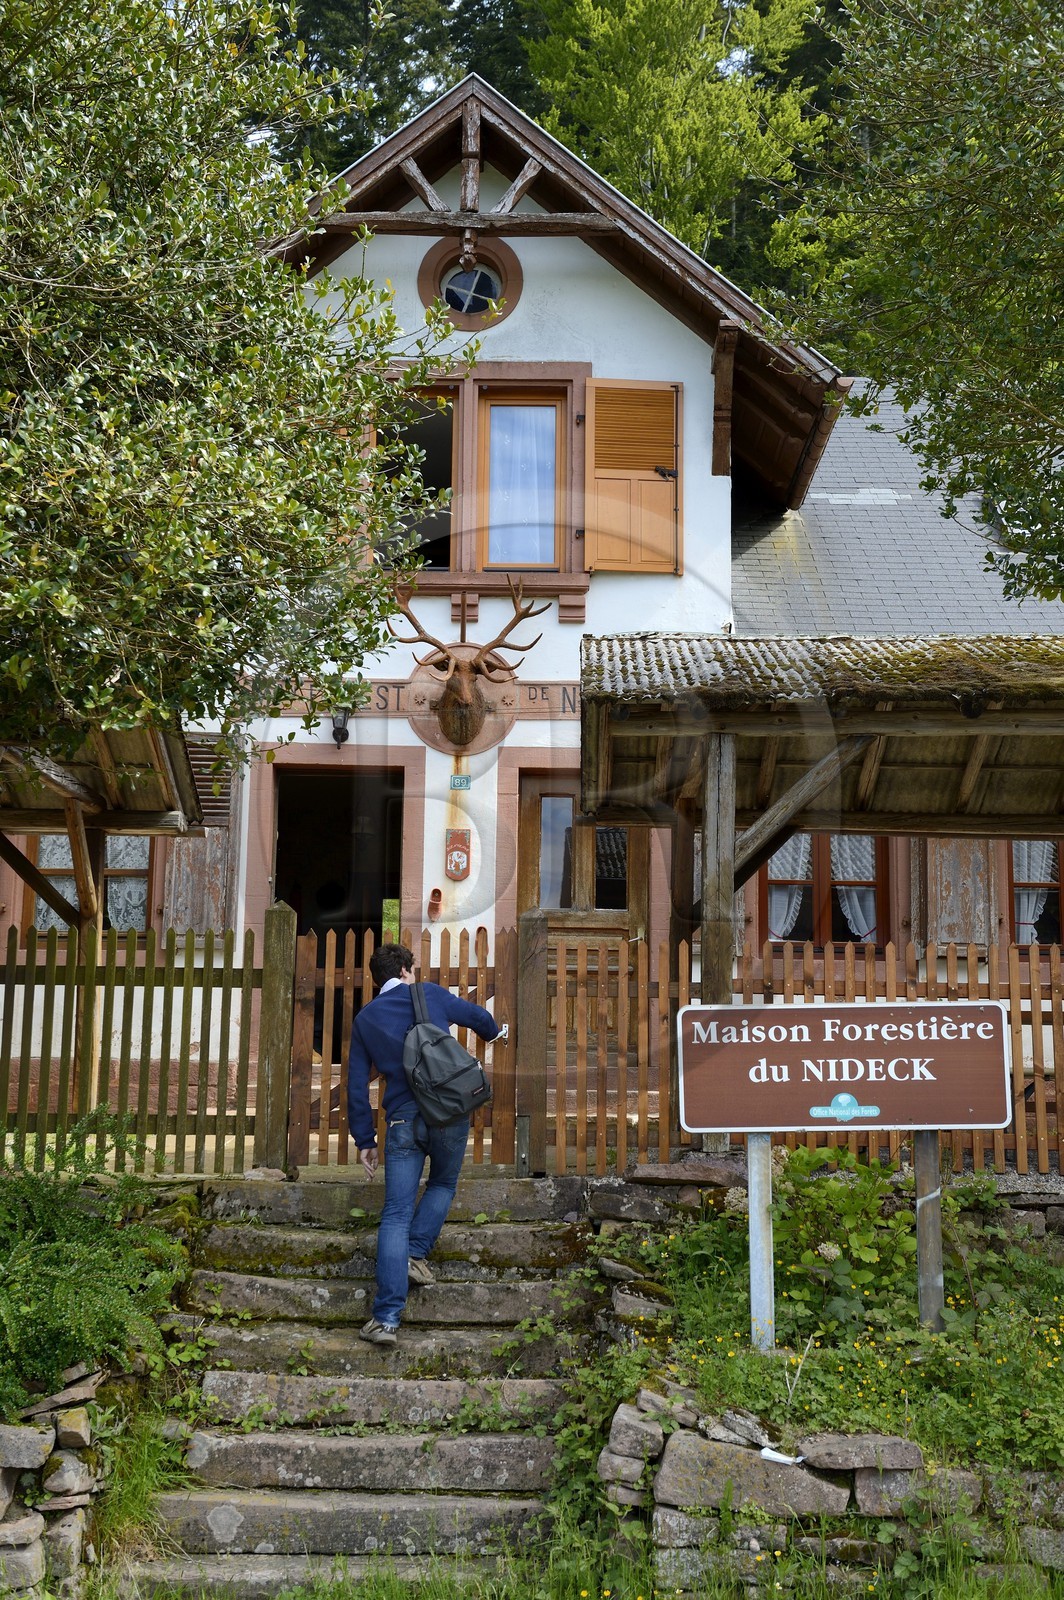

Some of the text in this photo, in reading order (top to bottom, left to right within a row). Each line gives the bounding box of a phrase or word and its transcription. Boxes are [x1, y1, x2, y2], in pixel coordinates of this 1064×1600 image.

[528, 686, 550, 701] DE
[454, 779, 467, 787] 89
[691, 1015, 995, 1044] Maison Forestière
[748, 1057, 937, 1083] du NIDECK
[812, 1107, 828, 1116] Office
[828, 1107, 851, 1116] National
[851, 1107, 860, 1116] des
